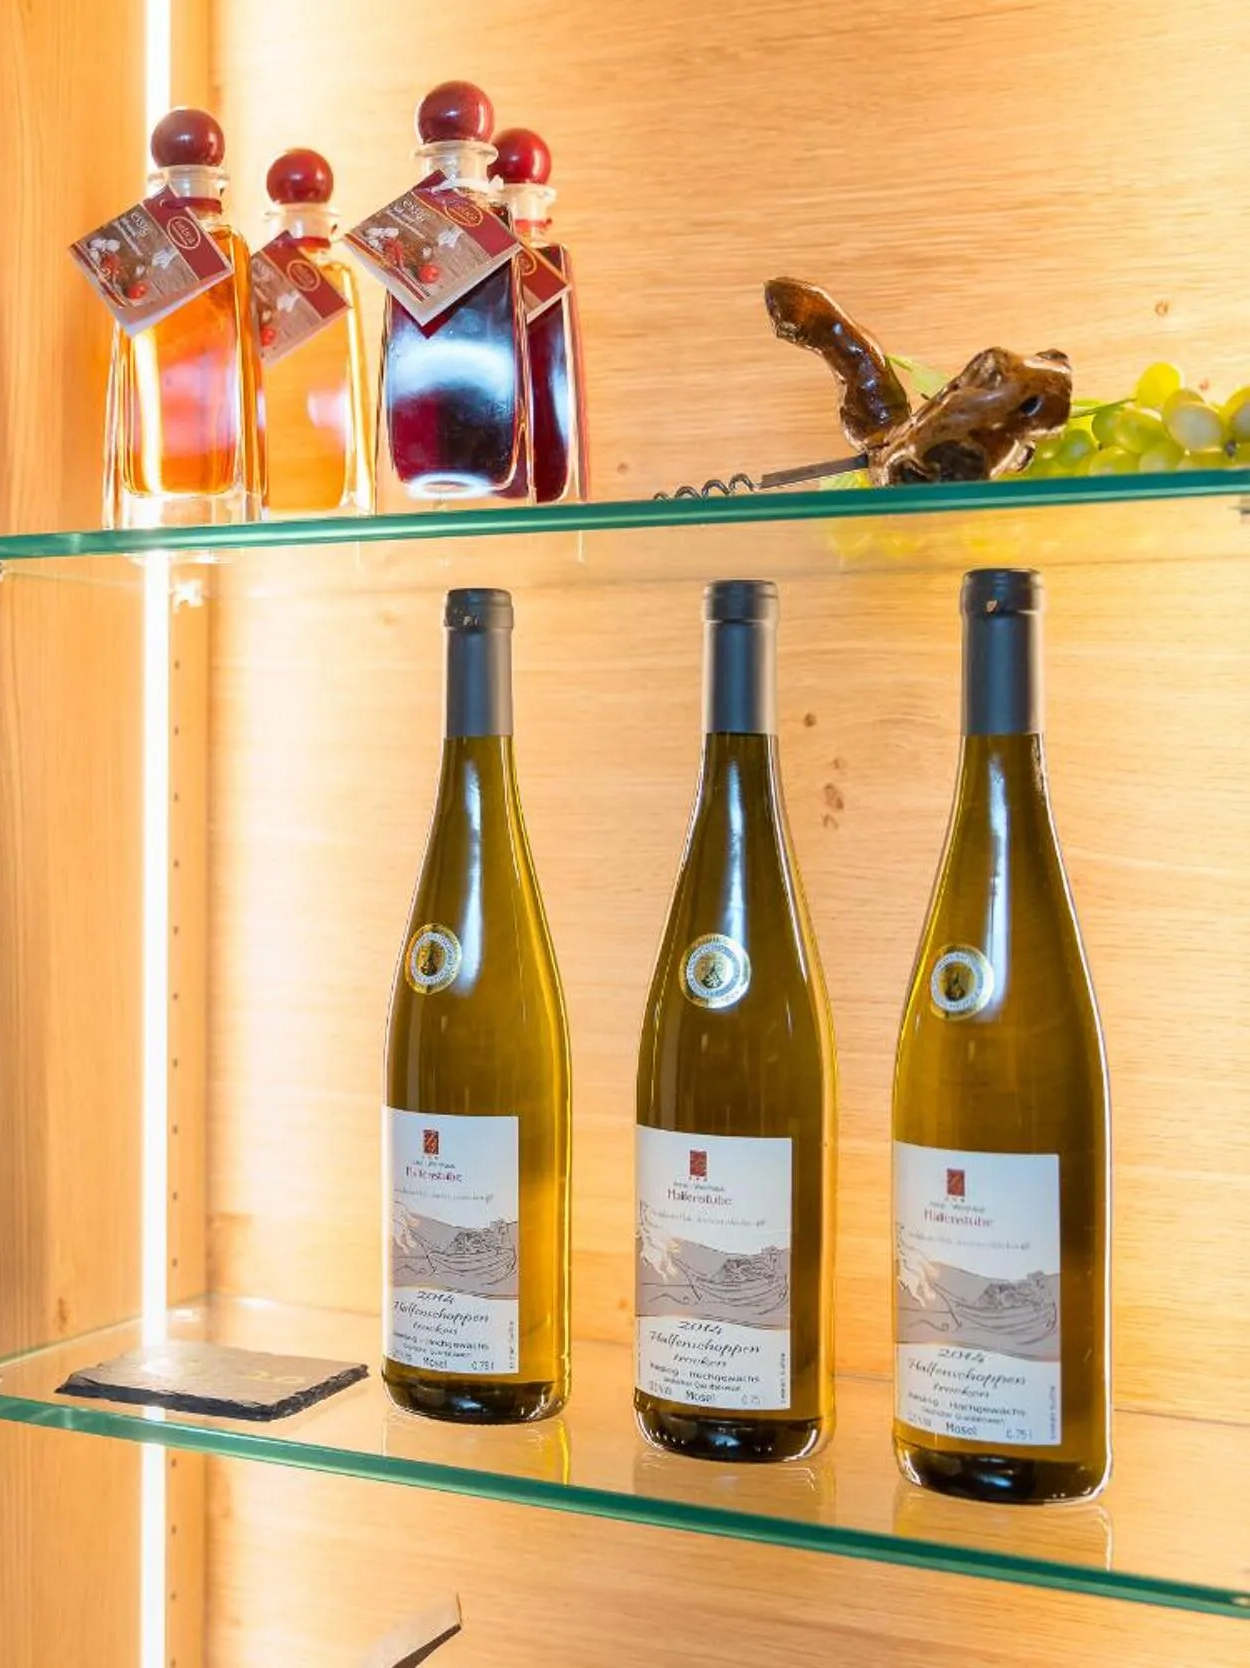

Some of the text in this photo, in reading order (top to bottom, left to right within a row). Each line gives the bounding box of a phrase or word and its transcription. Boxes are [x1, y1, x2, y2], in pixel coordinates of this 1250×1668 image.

[678, 1321, 723, 1335] 2014
[937, 1349, 985, 1363] 2014
[945, 1422, 978, 1436] Mosel
